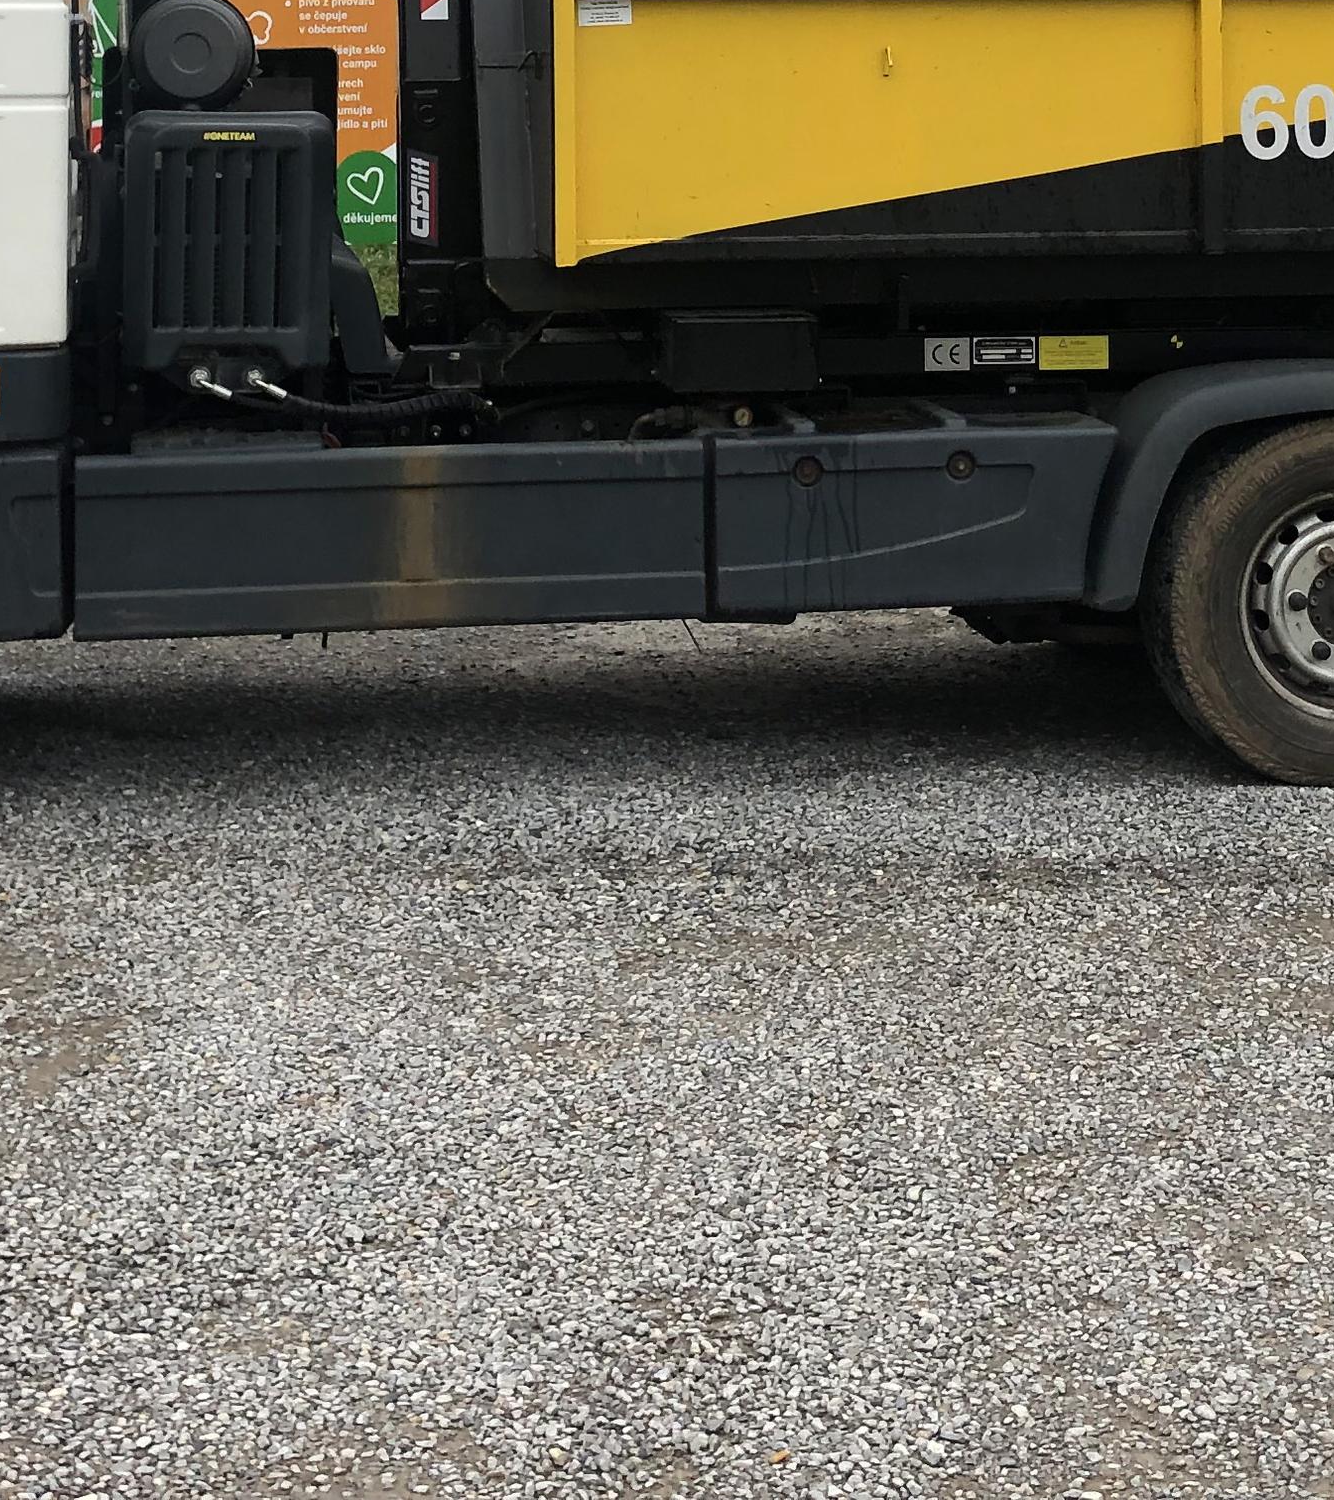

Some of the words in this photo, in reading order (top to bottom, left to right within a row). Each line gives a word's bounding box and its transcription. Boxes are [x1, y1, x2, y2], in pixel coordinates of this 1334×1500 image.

[298, 12, 311, 20] se
[308, 23, 368, 34] občerstvení
[364, 45, 386, 54] sklo
[342, 60, 377, 70] campu
